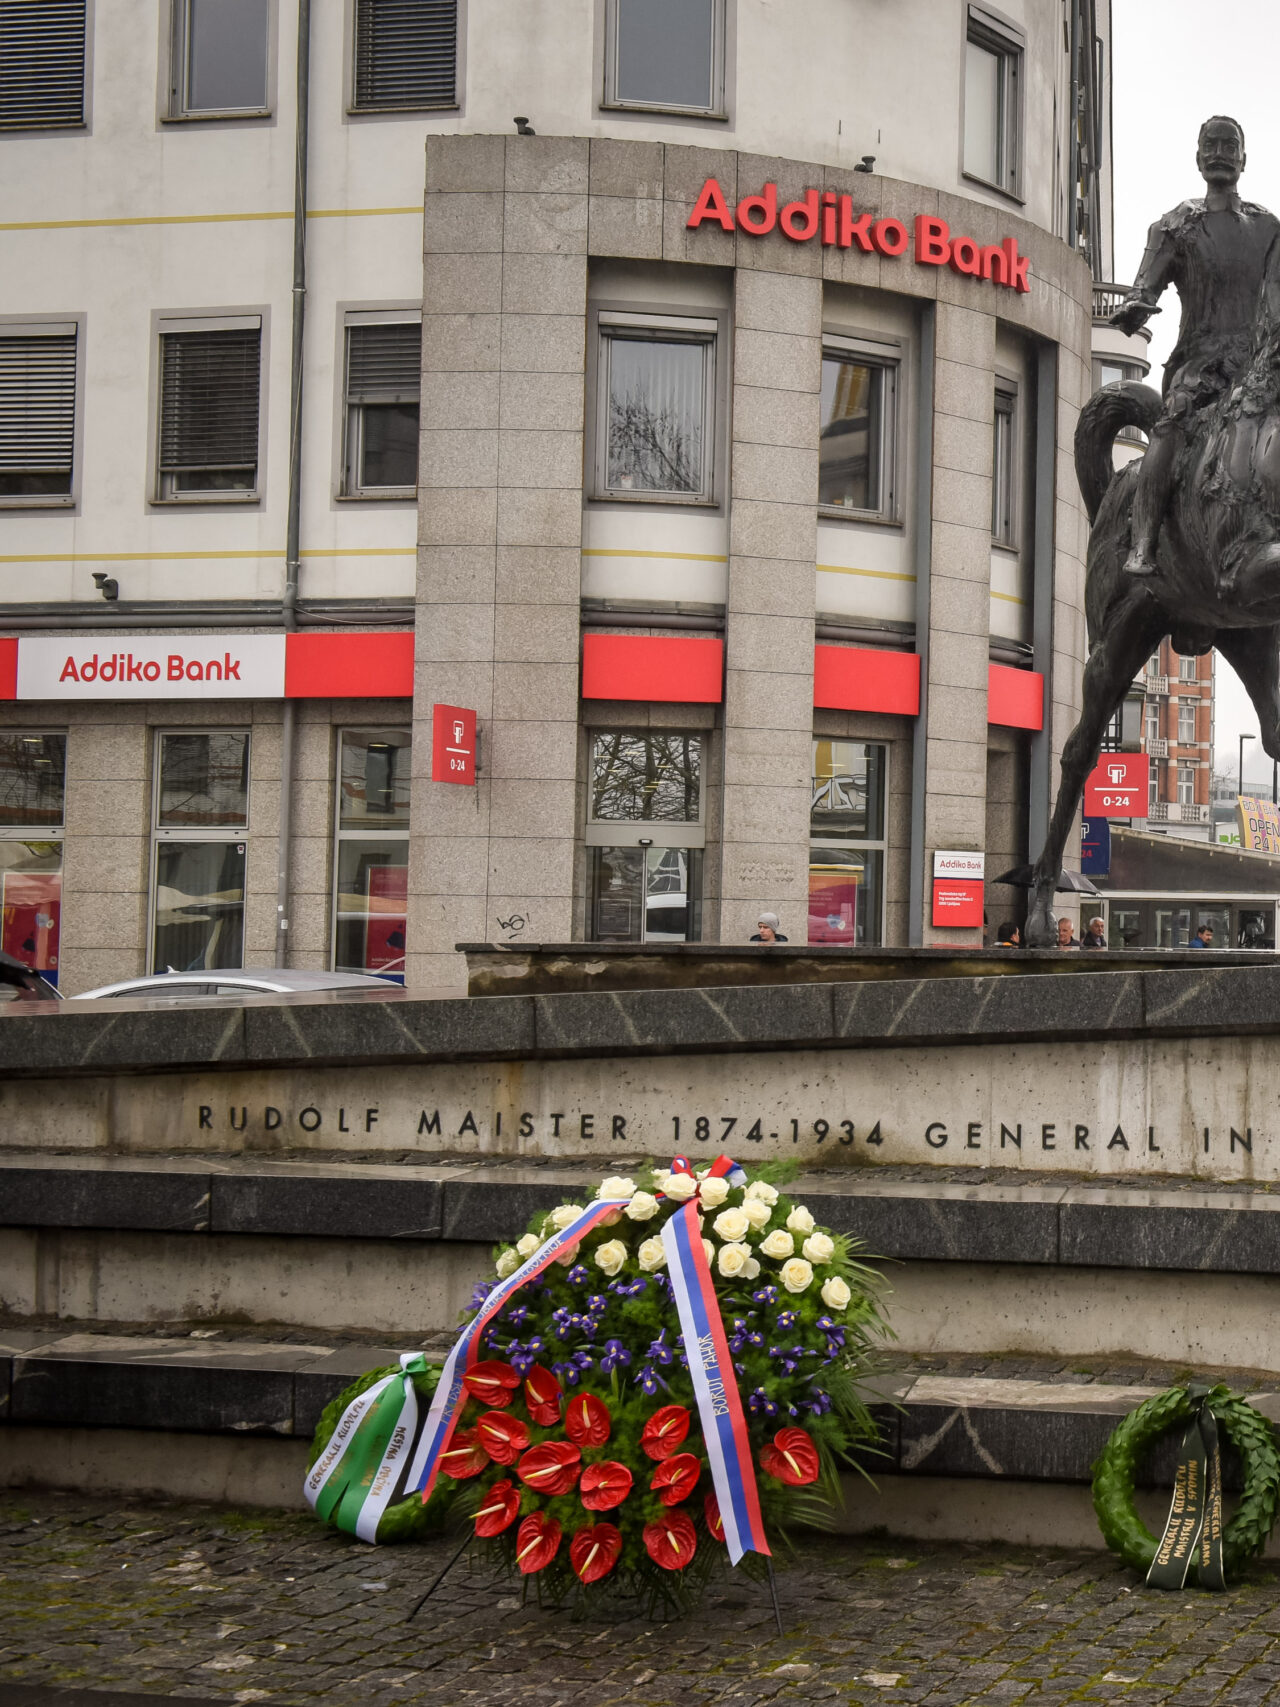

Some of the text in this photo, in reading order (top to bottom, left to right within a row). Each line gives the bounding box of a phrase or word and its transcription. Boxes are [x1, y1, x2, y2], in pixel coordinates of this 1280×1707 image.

[686, 178, 1031, 293] Addiko Bank
[59, 652, 242, 682] Addiko Bank
[450, 757, 466, 772] 0-24
[1102, 795, 1130, 807] 0-24
[1249, 817, 1280, 838] OPEN
[1254, 835, 1270, 851] 24
[1273, 839, 1280, 854] h
[940, 860, 982, 870] Addiko Bank
[199, 1105, 380, 1134] RUDOLF
[417, 1109, 628, 1140] MAISTER
[671, 1115, 884, 1146] 1874-1934
[924, 1120, 1161, 1151] GENERAL
[1203, 1126, 1253, 1154] IN
[515, 1239, 564, 1283] SLOVENIJE
[698, 1332, 730, 1416] BORUT PAHOR
[309, 1442, 342, 1490] GENERALU
[1173, 1518, 1196, 1558] MAISTRU
[1187, 1459, 1198, 1500] SPOMIN
[1211, 1494, 1221, 1541] GENERAL
[1157, 1518, 1182, 1565] GENERALU
